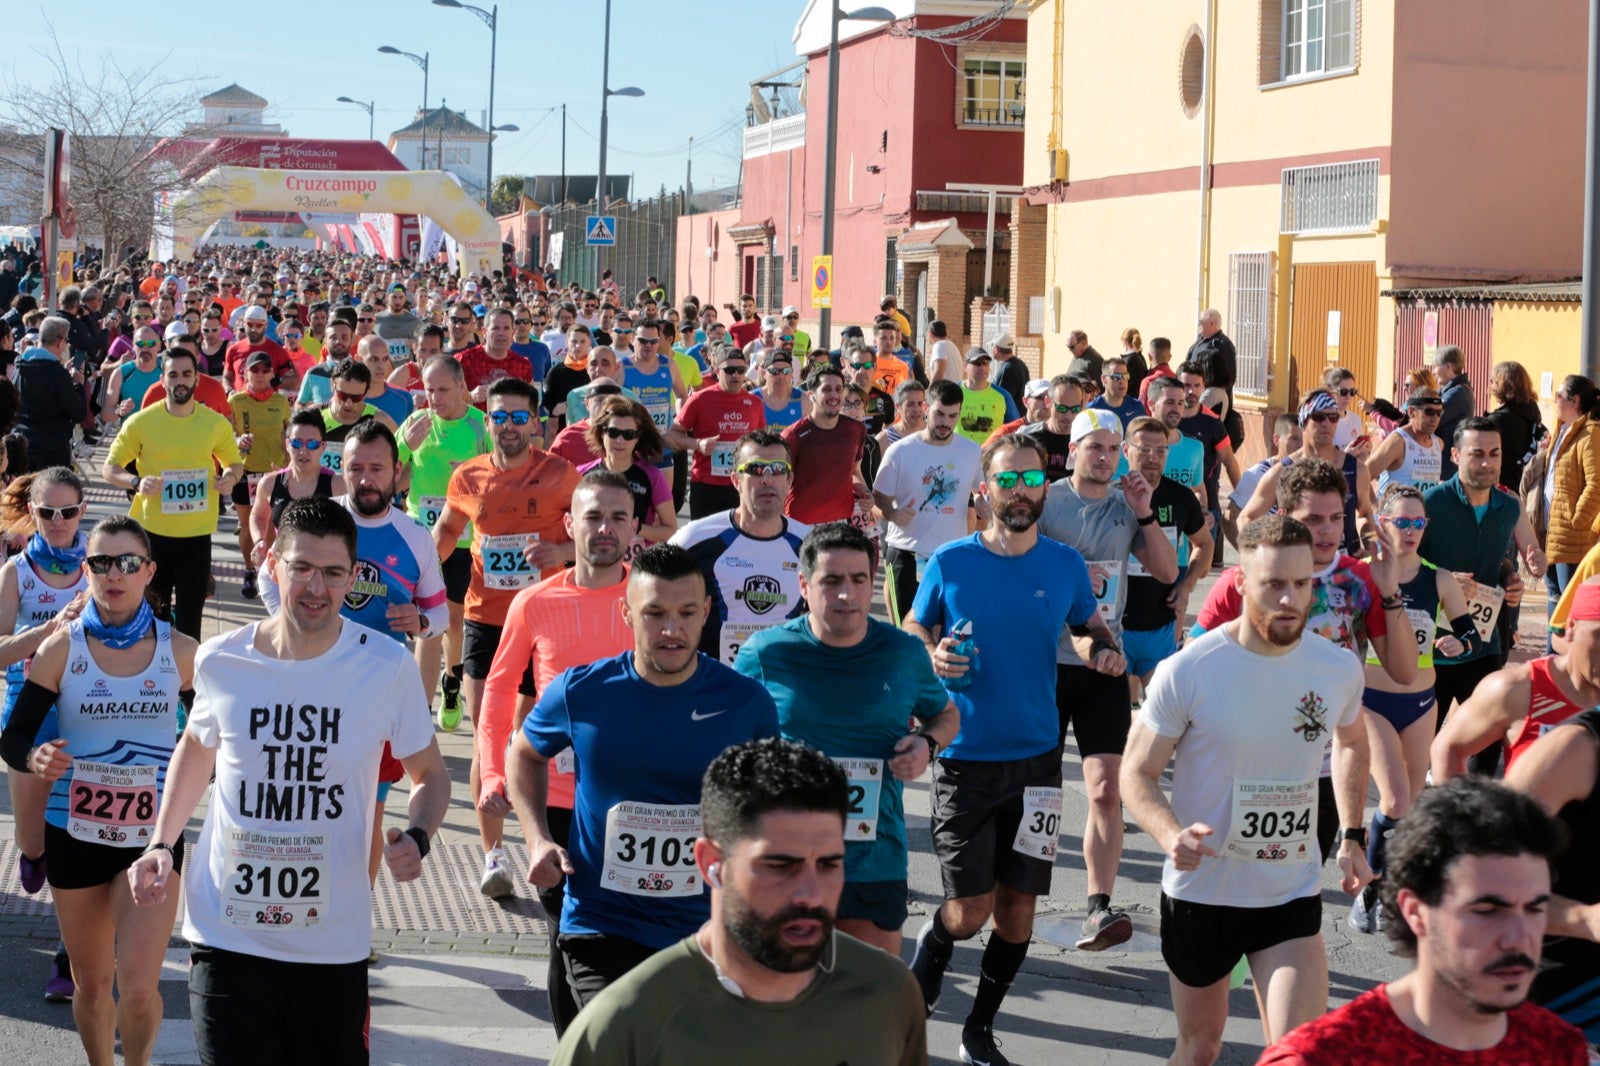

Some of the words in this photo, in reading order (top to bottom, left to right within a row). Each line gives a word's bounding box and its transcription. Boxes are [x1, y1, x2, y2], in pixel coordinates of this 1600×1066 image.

[284, 147, 337, 158] Diputación
[284, 159, 296, 169] de
[297, 159, 337, 170] Granada
[286, 176, 377, 194] Cruzcampo
[294, 195, 338, 208] Radler
[389, 345, 406, 354] 311
[724, 411, 743, 423] edp
[165, 481, 204, 499] 1091
[489, 551, 530, 571] 232
[80, 701, 169, 714] MARACENA
[250, 704, 341, 744] PUSH
[95, 764, 109, 774] GRAN
[110, 766, 130, 776] PREMIO
[131, 767, 137, 776] DE
[138, 767, 154, 777] FONDO
[263, 744, 328, 782] THE
[75, 786, 153, 821] 2278
[240, 780, 345, 821] LIMITS
[848, 785, 865, 813] 2
[634, 806, 652, 816] GRAN
[654, 809, 678, 818] PREMIO
[679, 810, 686, 818] DE
[1240, 808, 1310, 838] 3034
[251, 833, 267, 844] GRAN
[268, 837, 292, 846] PREMIO
[294, 837, 301, 845] DE
[303, 836, 324, 845] FONDO
[617, 833, 697, 867] 3103
[234, 863, 320, 898] 3102
